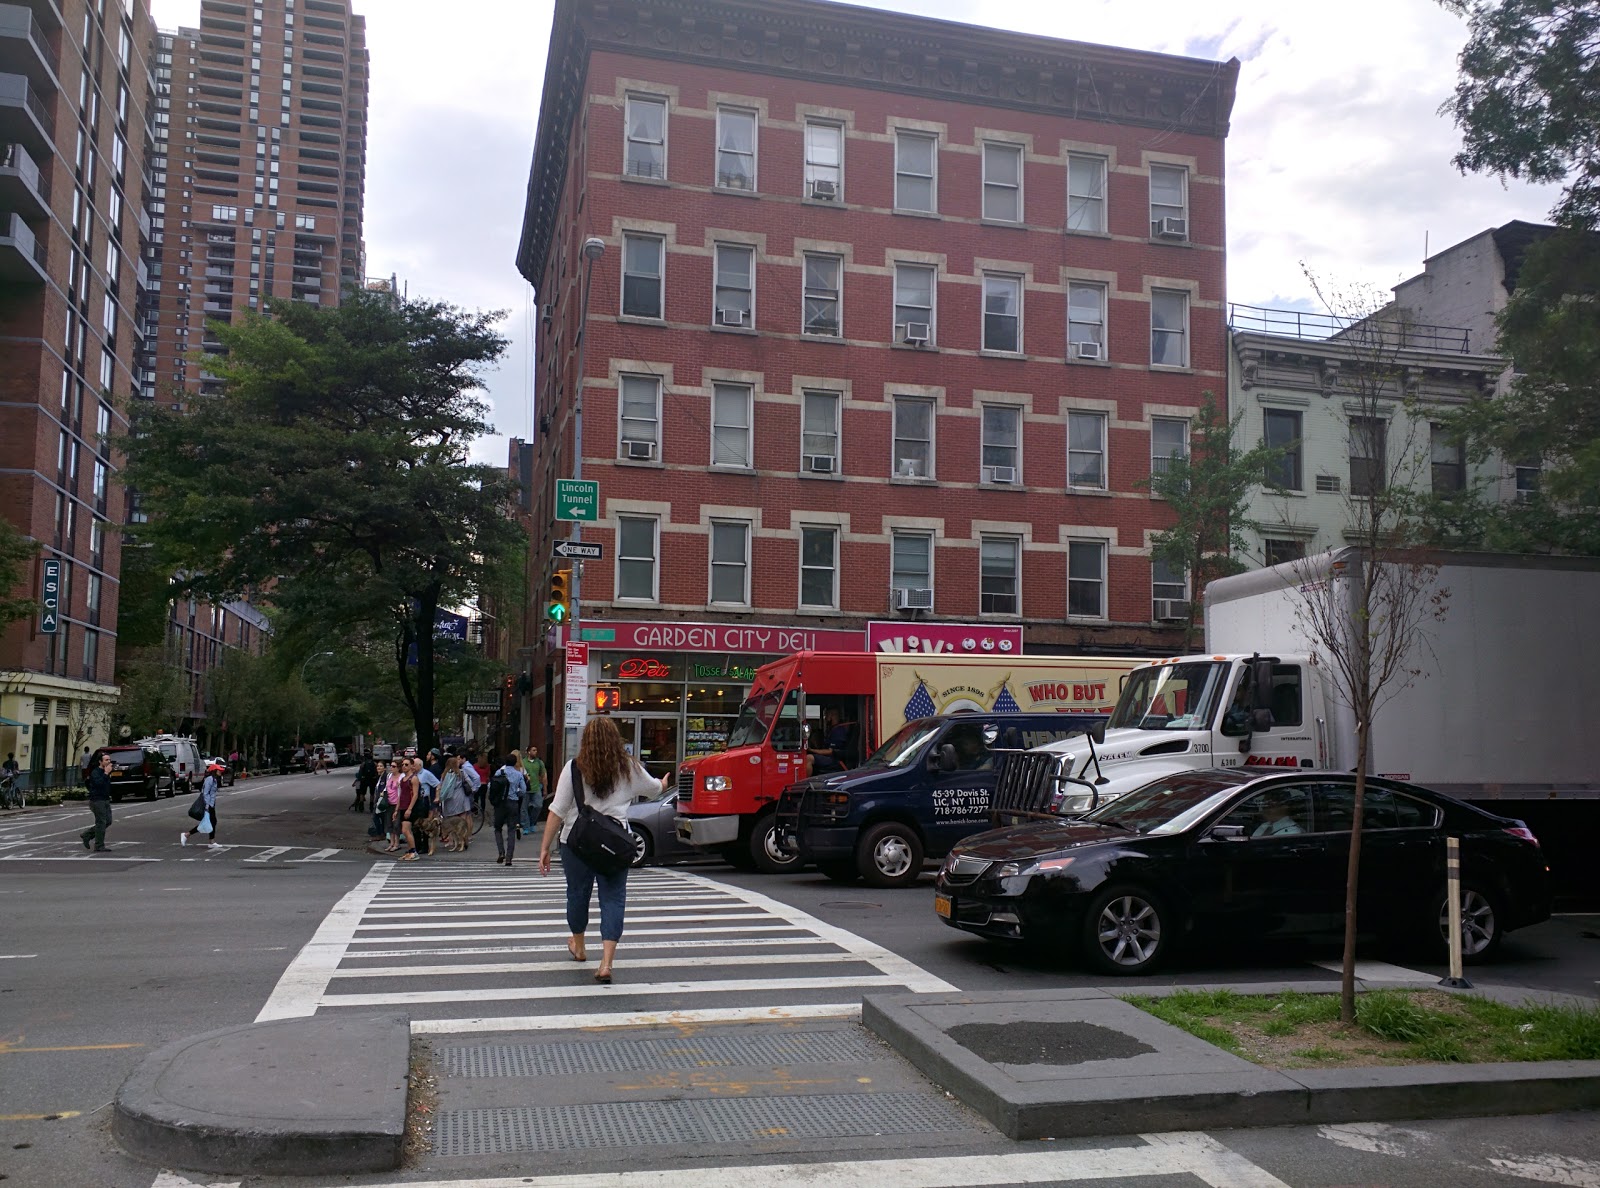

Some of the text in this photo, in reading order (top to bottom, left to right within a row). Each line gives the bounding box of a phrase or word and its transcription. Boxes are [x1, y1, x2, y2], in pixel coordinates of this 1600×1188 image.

[561, 483, 593, 493] Lincoln
[562, 494, 593, 504] Tunnel
[581, 547, 596, 555] WAY
[43, 566, 58, 625] ESCA
[633, 626, 816, 651] GARDEN CITY DELI
[618, 658, 669, 678] Deli
[942, 685, 985, 698] SINCE 1898
[1028, 683, 1106, 702] WHO BUT
[612, 691, 619, 707] 3
[566, 703, 571, 711] 2
[1193, 743, 1210, 753] 3700
[1099, 752, 1132, 761] SALEM
[1244, 755, 1298, 767] SALEM
[932, 788, 990, 798] 45-39 Davis St.
[933, 796, 989, 807] LIC, NY 11101
